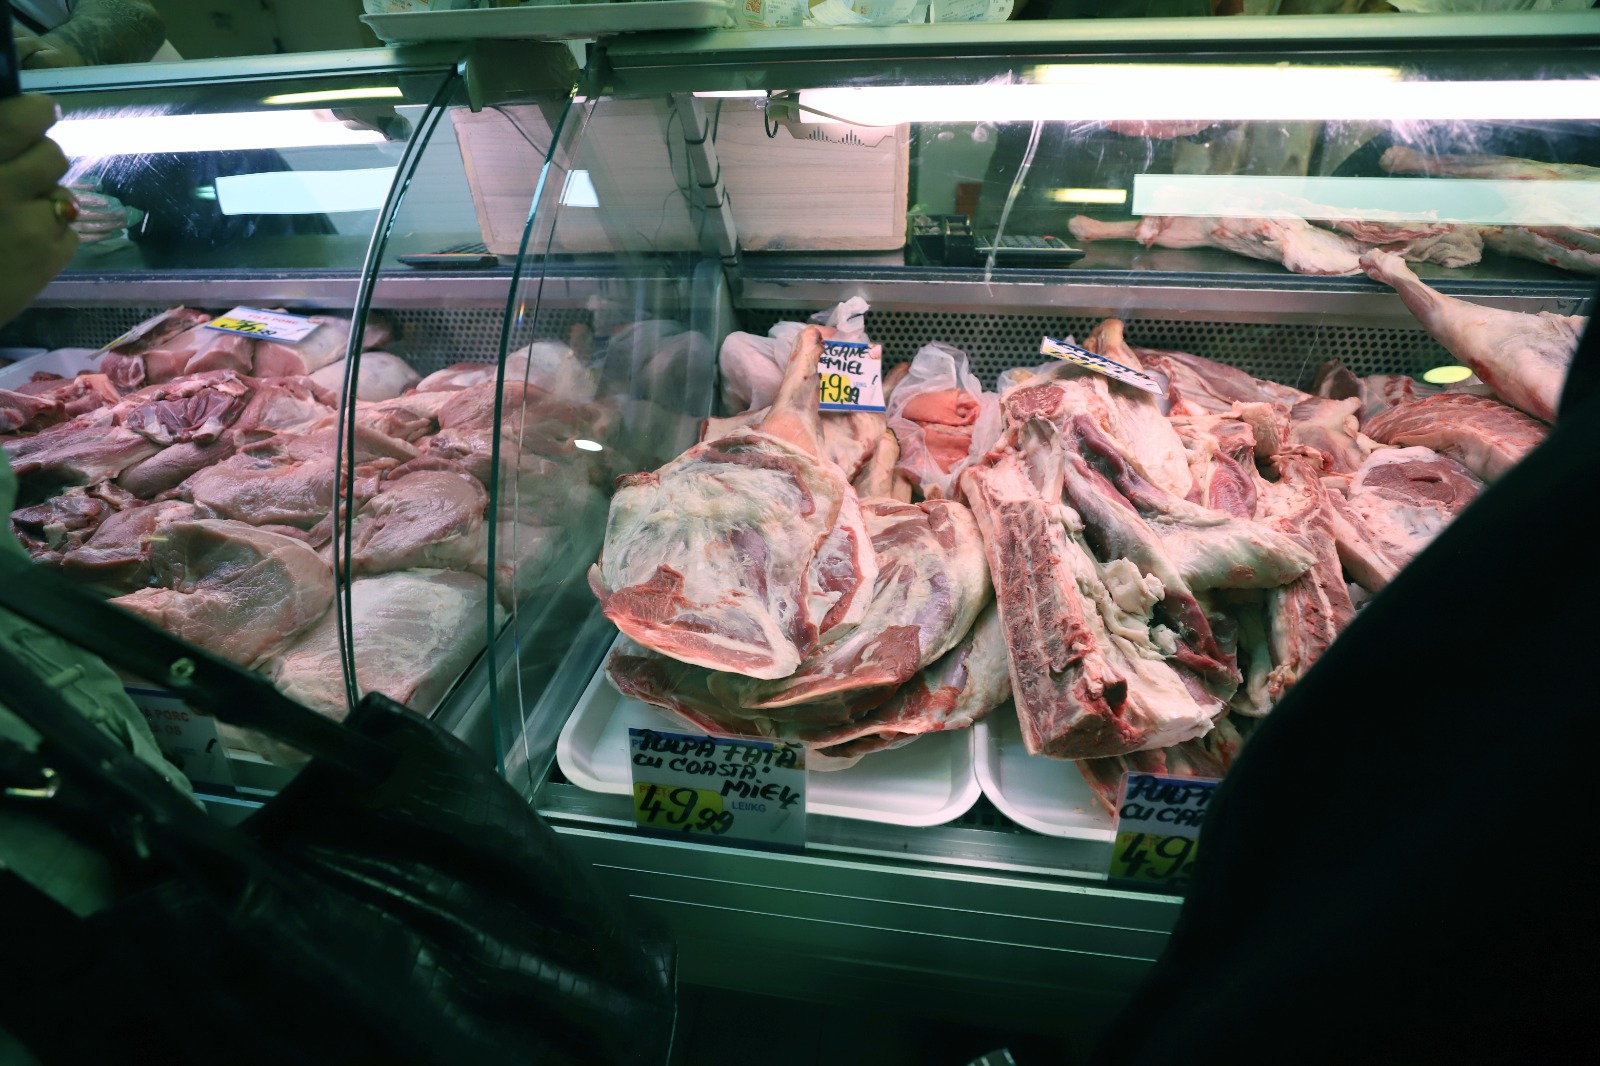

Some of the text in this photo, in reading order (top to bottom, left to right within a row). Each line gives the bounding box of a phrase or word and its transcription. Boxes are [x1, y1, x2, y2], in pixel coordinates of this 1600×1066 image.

[632, 752, 664, 769] CU
[639, 784, 735, 835] 49,99
[731, 801, 767, 813] LEI/KG
[1119, 803, 1155, 821] CU
